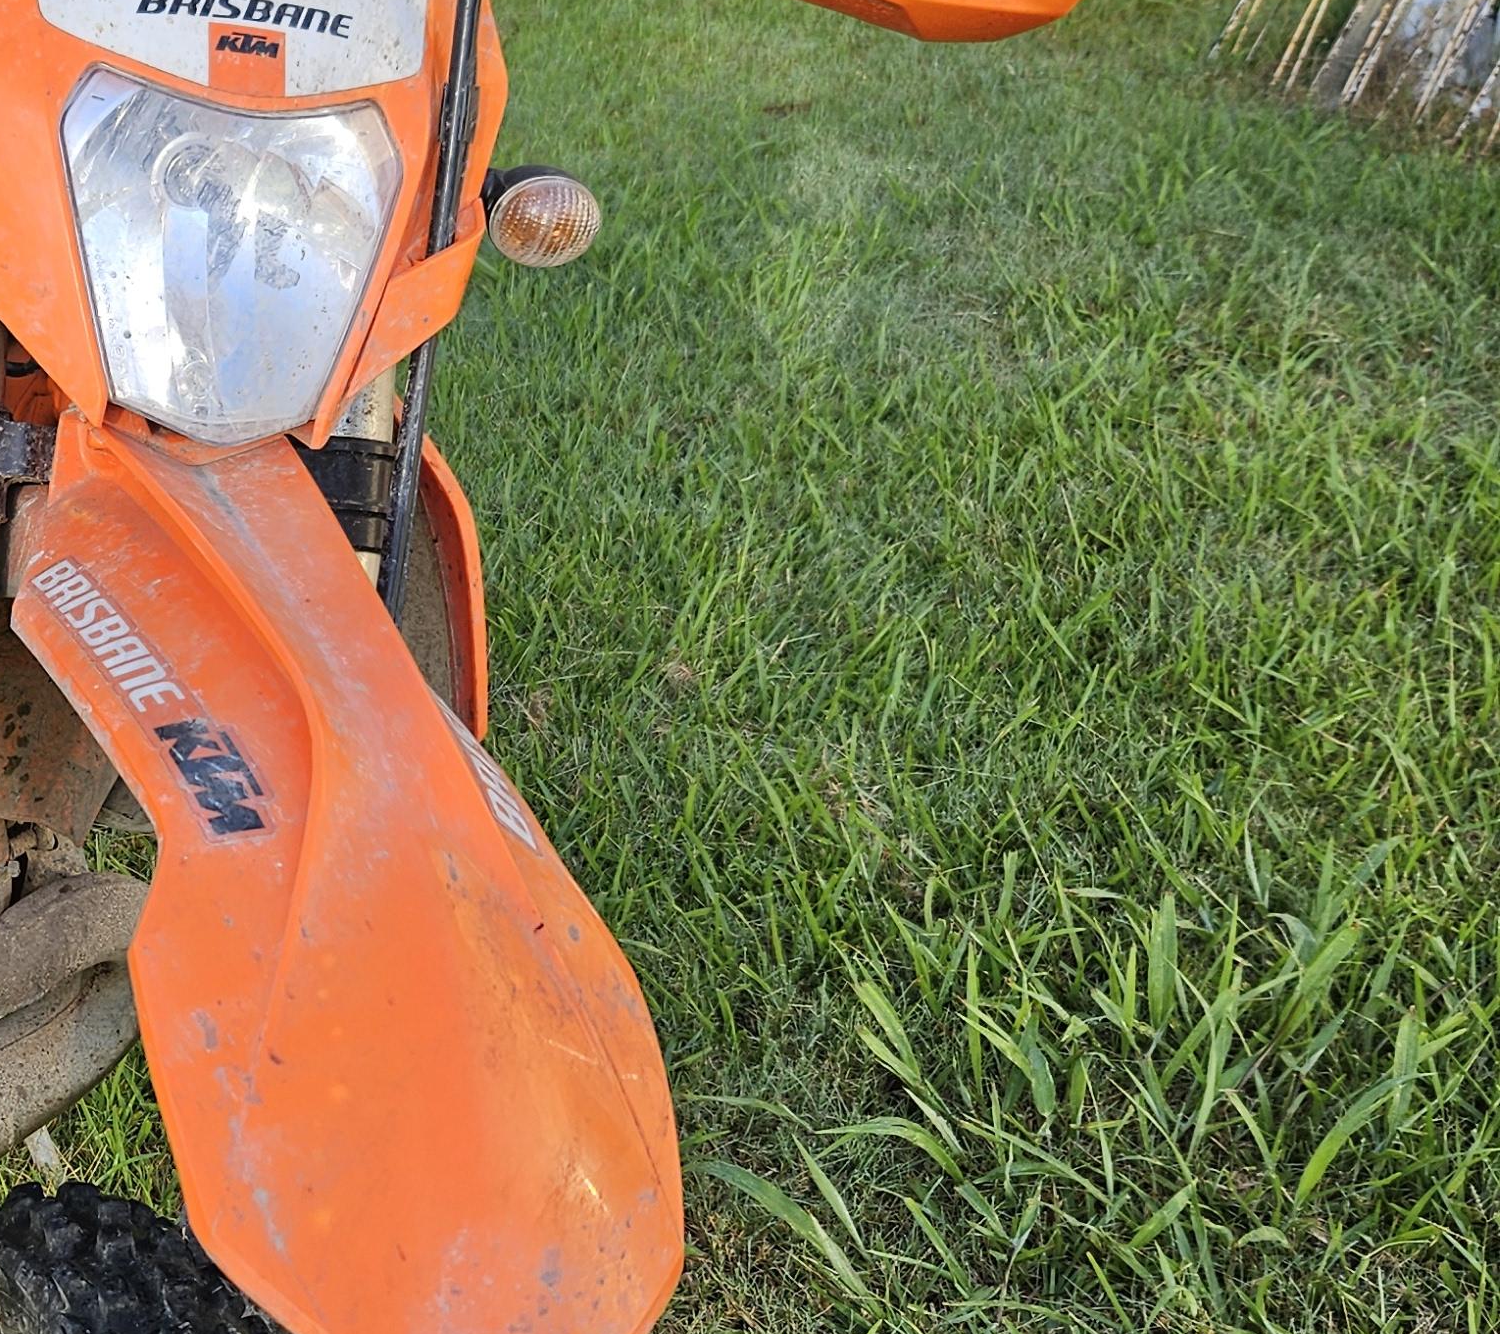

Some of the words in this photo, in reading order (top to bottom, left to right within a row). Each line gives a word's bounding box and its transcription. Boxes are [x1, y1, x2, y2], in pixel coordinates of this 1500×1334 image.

[215, 31, 280, 59] KTM
[31, 559, 186, 713] BRISBANE
[153, 718, 266, 836] KTM
